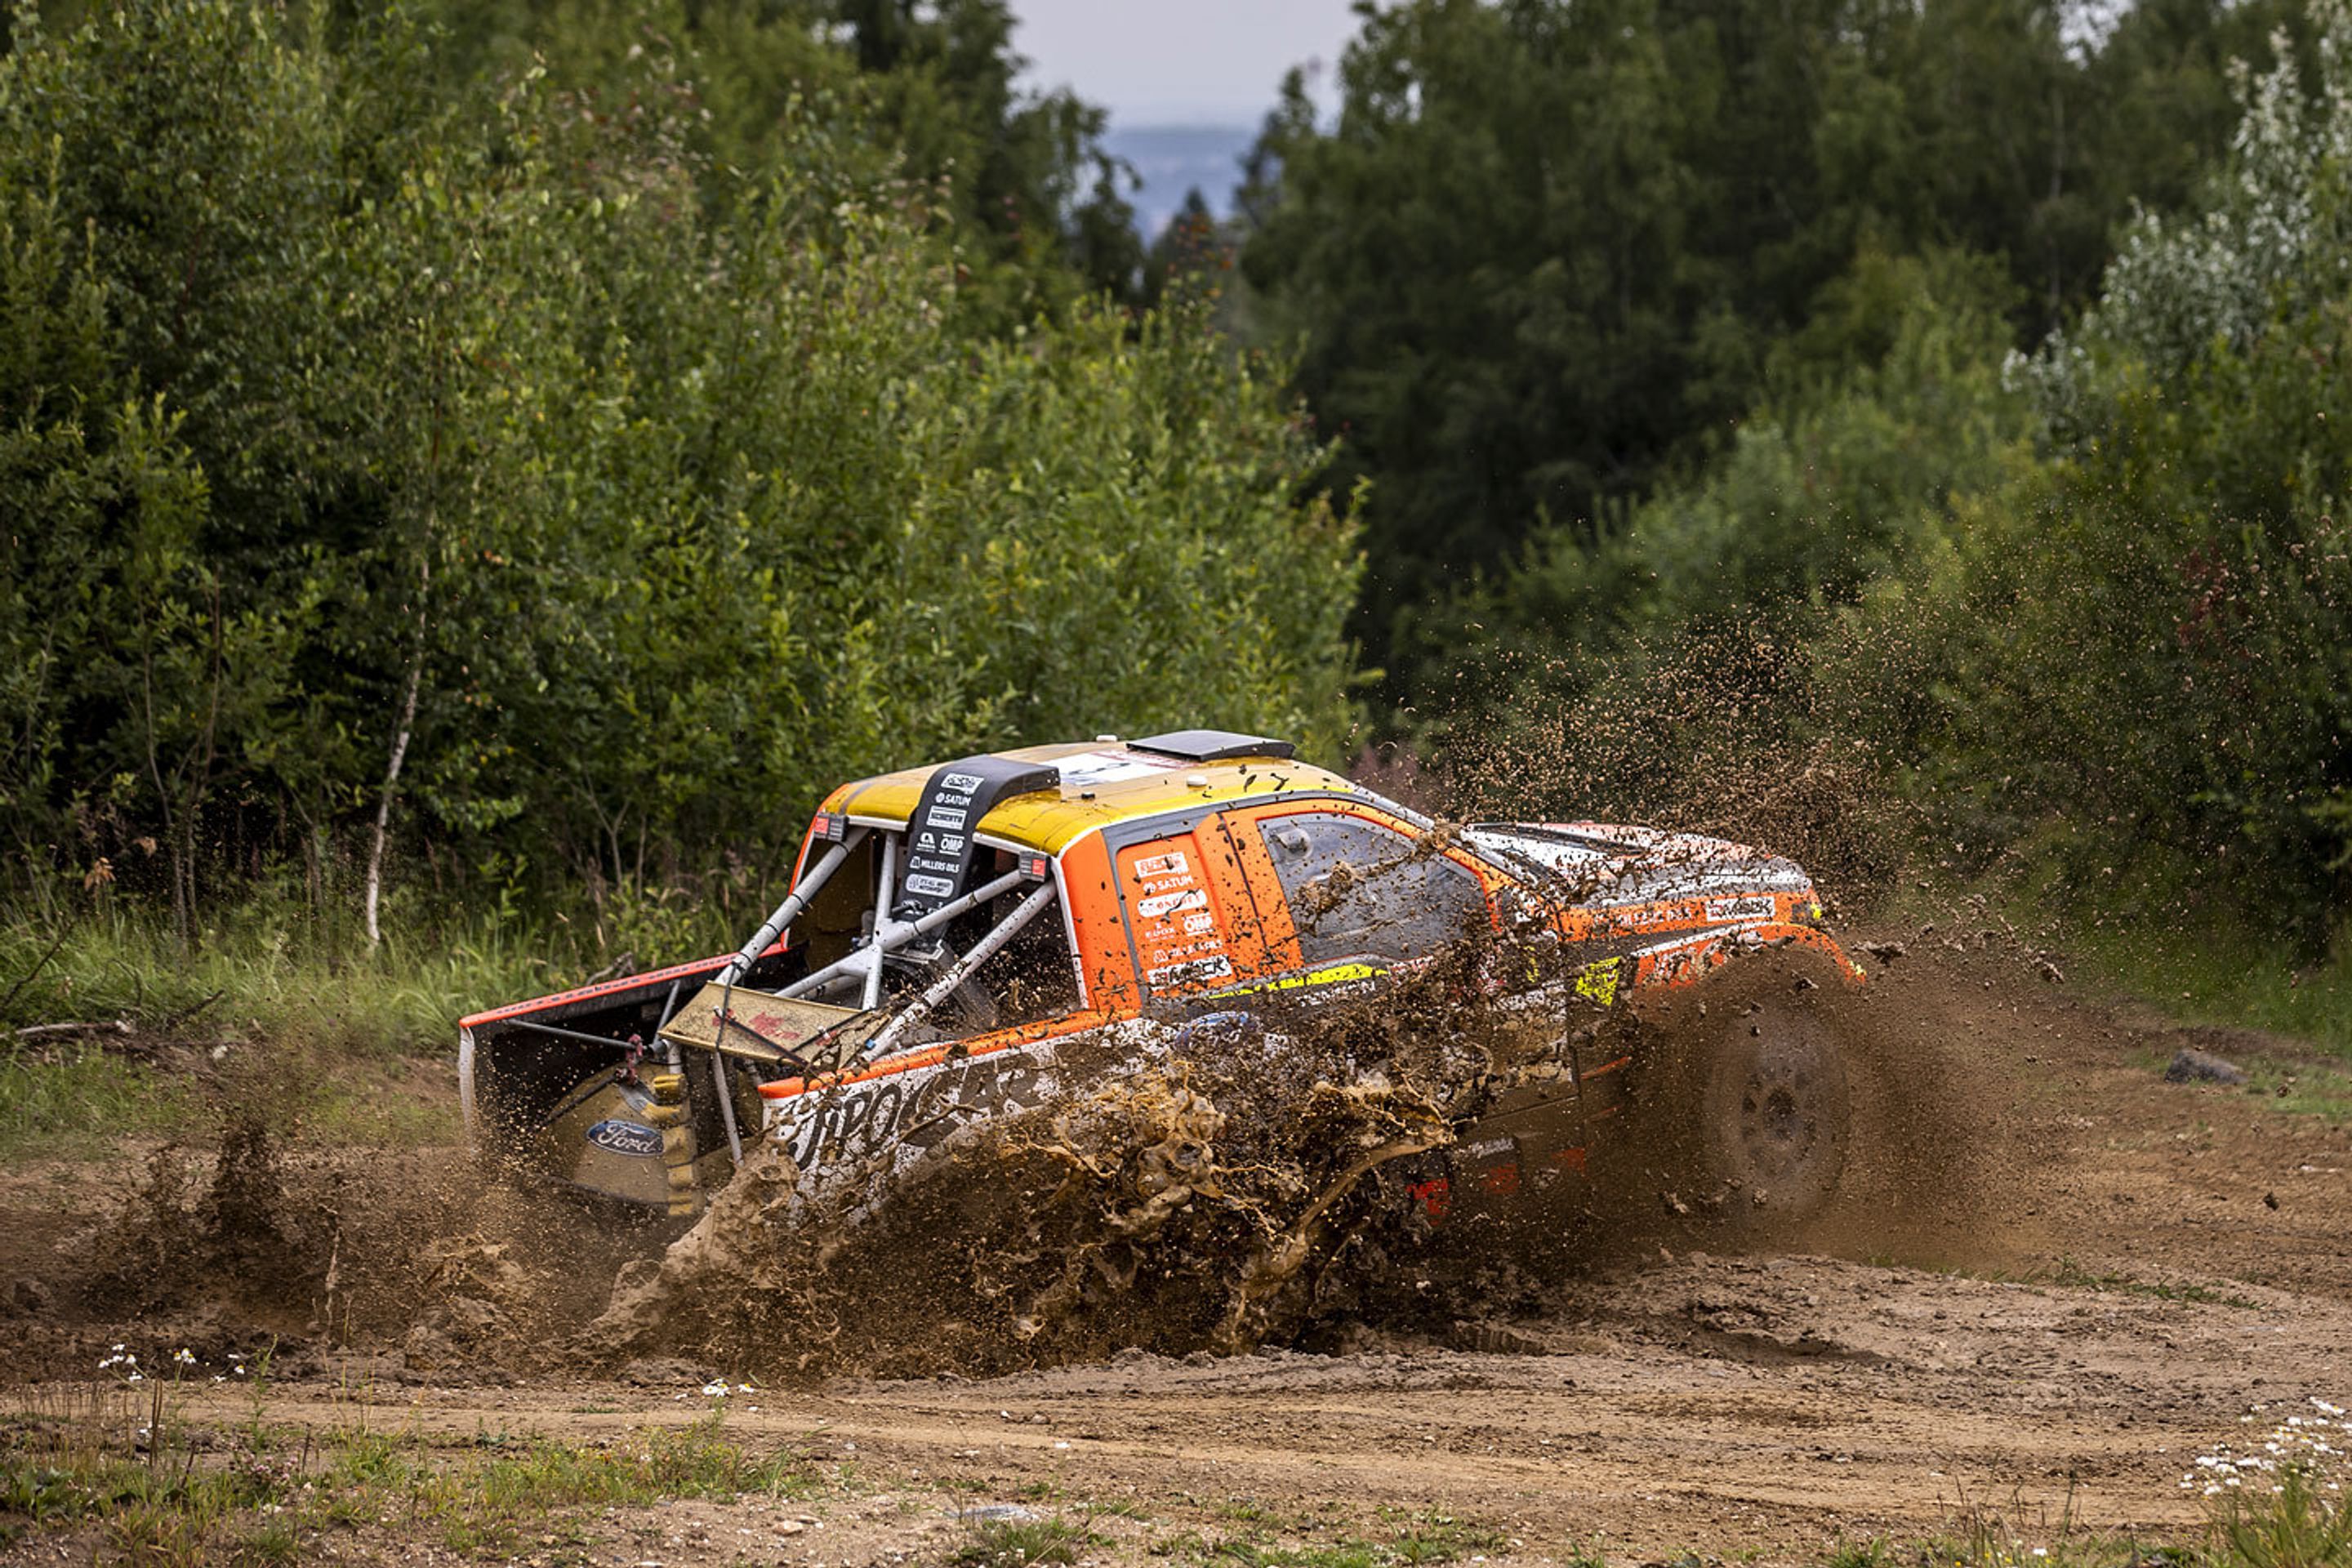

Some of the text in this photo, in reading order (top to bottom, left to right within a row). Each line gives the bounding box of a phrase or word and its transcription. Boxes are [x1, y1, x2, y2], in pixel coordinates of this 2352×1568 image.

[944, 793, 972, 807] SATUM
[1156, 875, 1193, 890] SATUM
[598, 1123, 660, 1152] Ford
